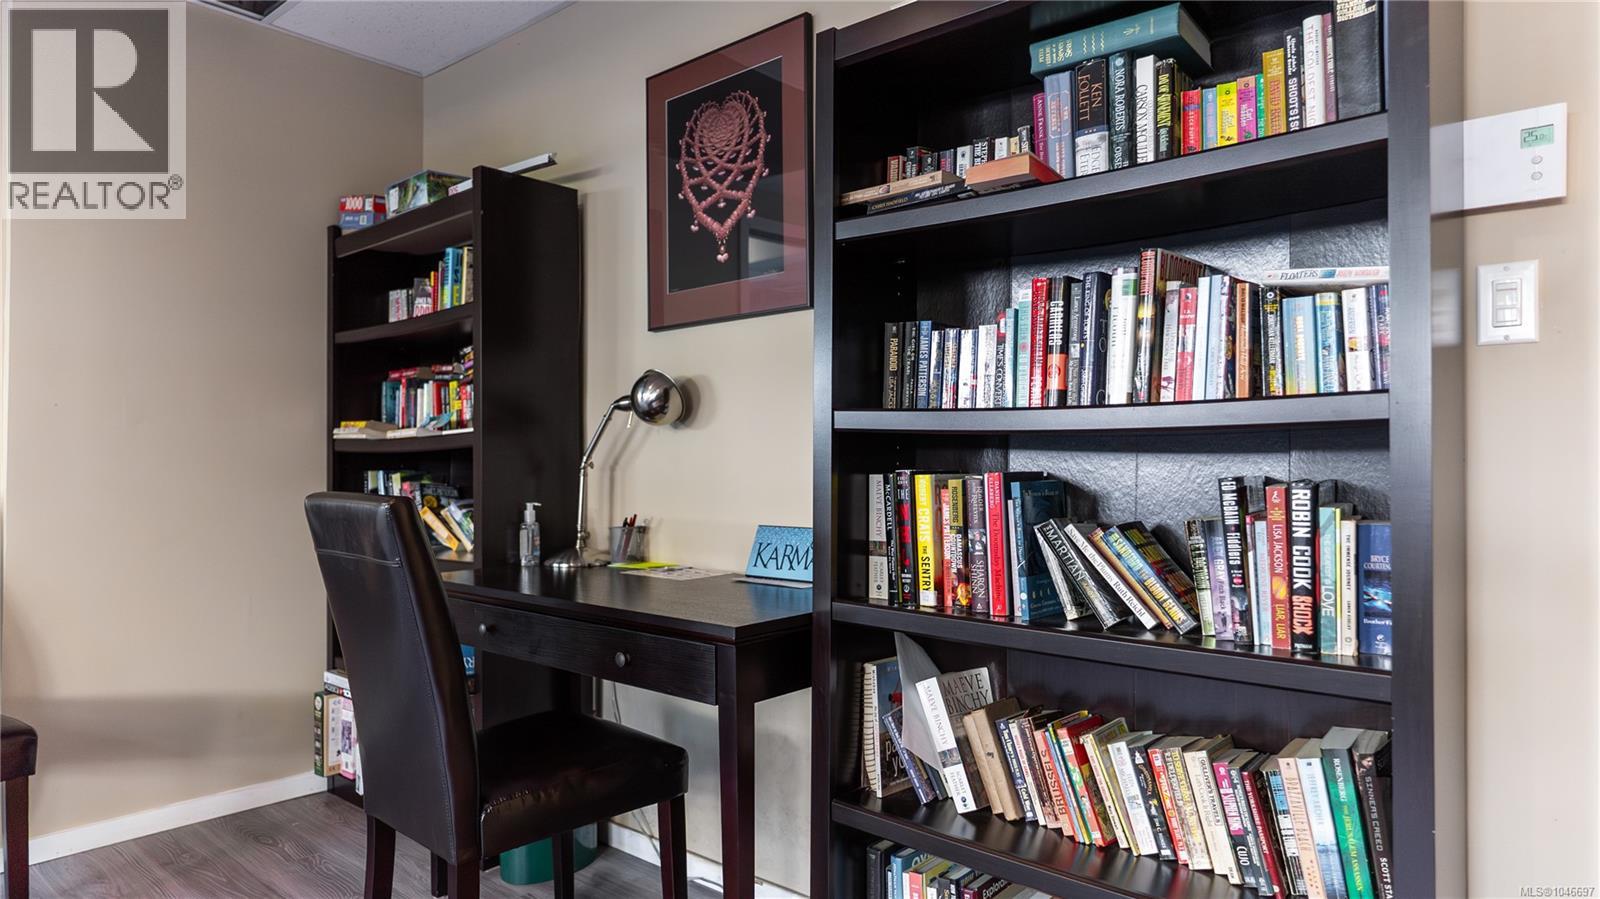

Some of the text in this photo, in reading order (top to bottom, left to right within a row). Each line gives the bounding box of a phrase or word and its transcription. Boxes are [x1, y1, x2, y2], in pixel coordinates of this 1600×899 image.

[1078, 75, 1090, 121] FOLLETT
[1091, 83, 1103, 107] KEN
[1114, 69, 1125, 131] NORA ROBERTS
[1136, 84, 1149, 120] CARSON
[1288, 77, 1299, 116] SHOOTS
[1037, 118, 1045, 139] FRANK
[345, 196, 363, 211] 1000
[1279, 270, 1319, 280] FLOATERS
[1048, 300, 1064, 346] CARRIERS
[1071, 296, 1080, 341] Lance Armstrong
[889, 337, 899, 371] PARANOID
[918, 335, 929, 397] JAMES PATTERSON
[994, 368, 1003, 406] CONVERT
[1220, 481, 1237, 490] ED
[875, 480, 883, 537] MAEVE BINCHY
[884, 484, 893, 531] McCARDELL
[952, 486, 960, 523] ROSENBERG
[1222, 493, 1240, 525] McBAIN
[918, 508, 930, 542] CRAIS
[943, 502, 951, 560] JAMES PATTERSON
[1272, 524, 1284, 539] LISA
[752, 542, 813, 571] KARM
[991, 513, 1002, 602] The Doomsday Machine
[1046, 528, 1086, 581] MARTIAN
[1213, 559, 1225, 580] GRAY
[1273, 540, 1284, 574] JACKSON
[1291, 489, 1314, 635] ROBIN COOK SHOCK
[921, 556, 931, 592] SENTRY
[976, 560, 986, 598] SHARON
[1095, 561, 1115, 584] Plums
[1113, 581, 1127, 599] Ruth
[1125, 595, 1145, 618] Reichl
[1218, 595, 1226, 609] Black
[1322, 586, 1335, 616] LOVE
[1276, 623, 1286, 639] LIAR
[942, 672, 984, 697] MAEVE
[945, 689, 989, 715] BINCHY
[926, 686, 949, 746] MAEVE BINCHY
[1041, 749, 1067, 816] BRUSSELS
[1199, 759, 1221, 823] GULLIVER'S TRAVELS
[1222, 793, 1238, 816] STEPHEN
[1243, 779, 1251, 792] THE
[1247, 791, 1260, 824] YORKSHIRE
[1332, 757, 1347, 802] ROSENBERG
[1342, 814, 1357, 858] JERUSALEM
[1235, 844, 1250, 867] CUJO
[1371, 820, 1383, 852] CREED
[1378, 856, 1391, 883] SCOTT
